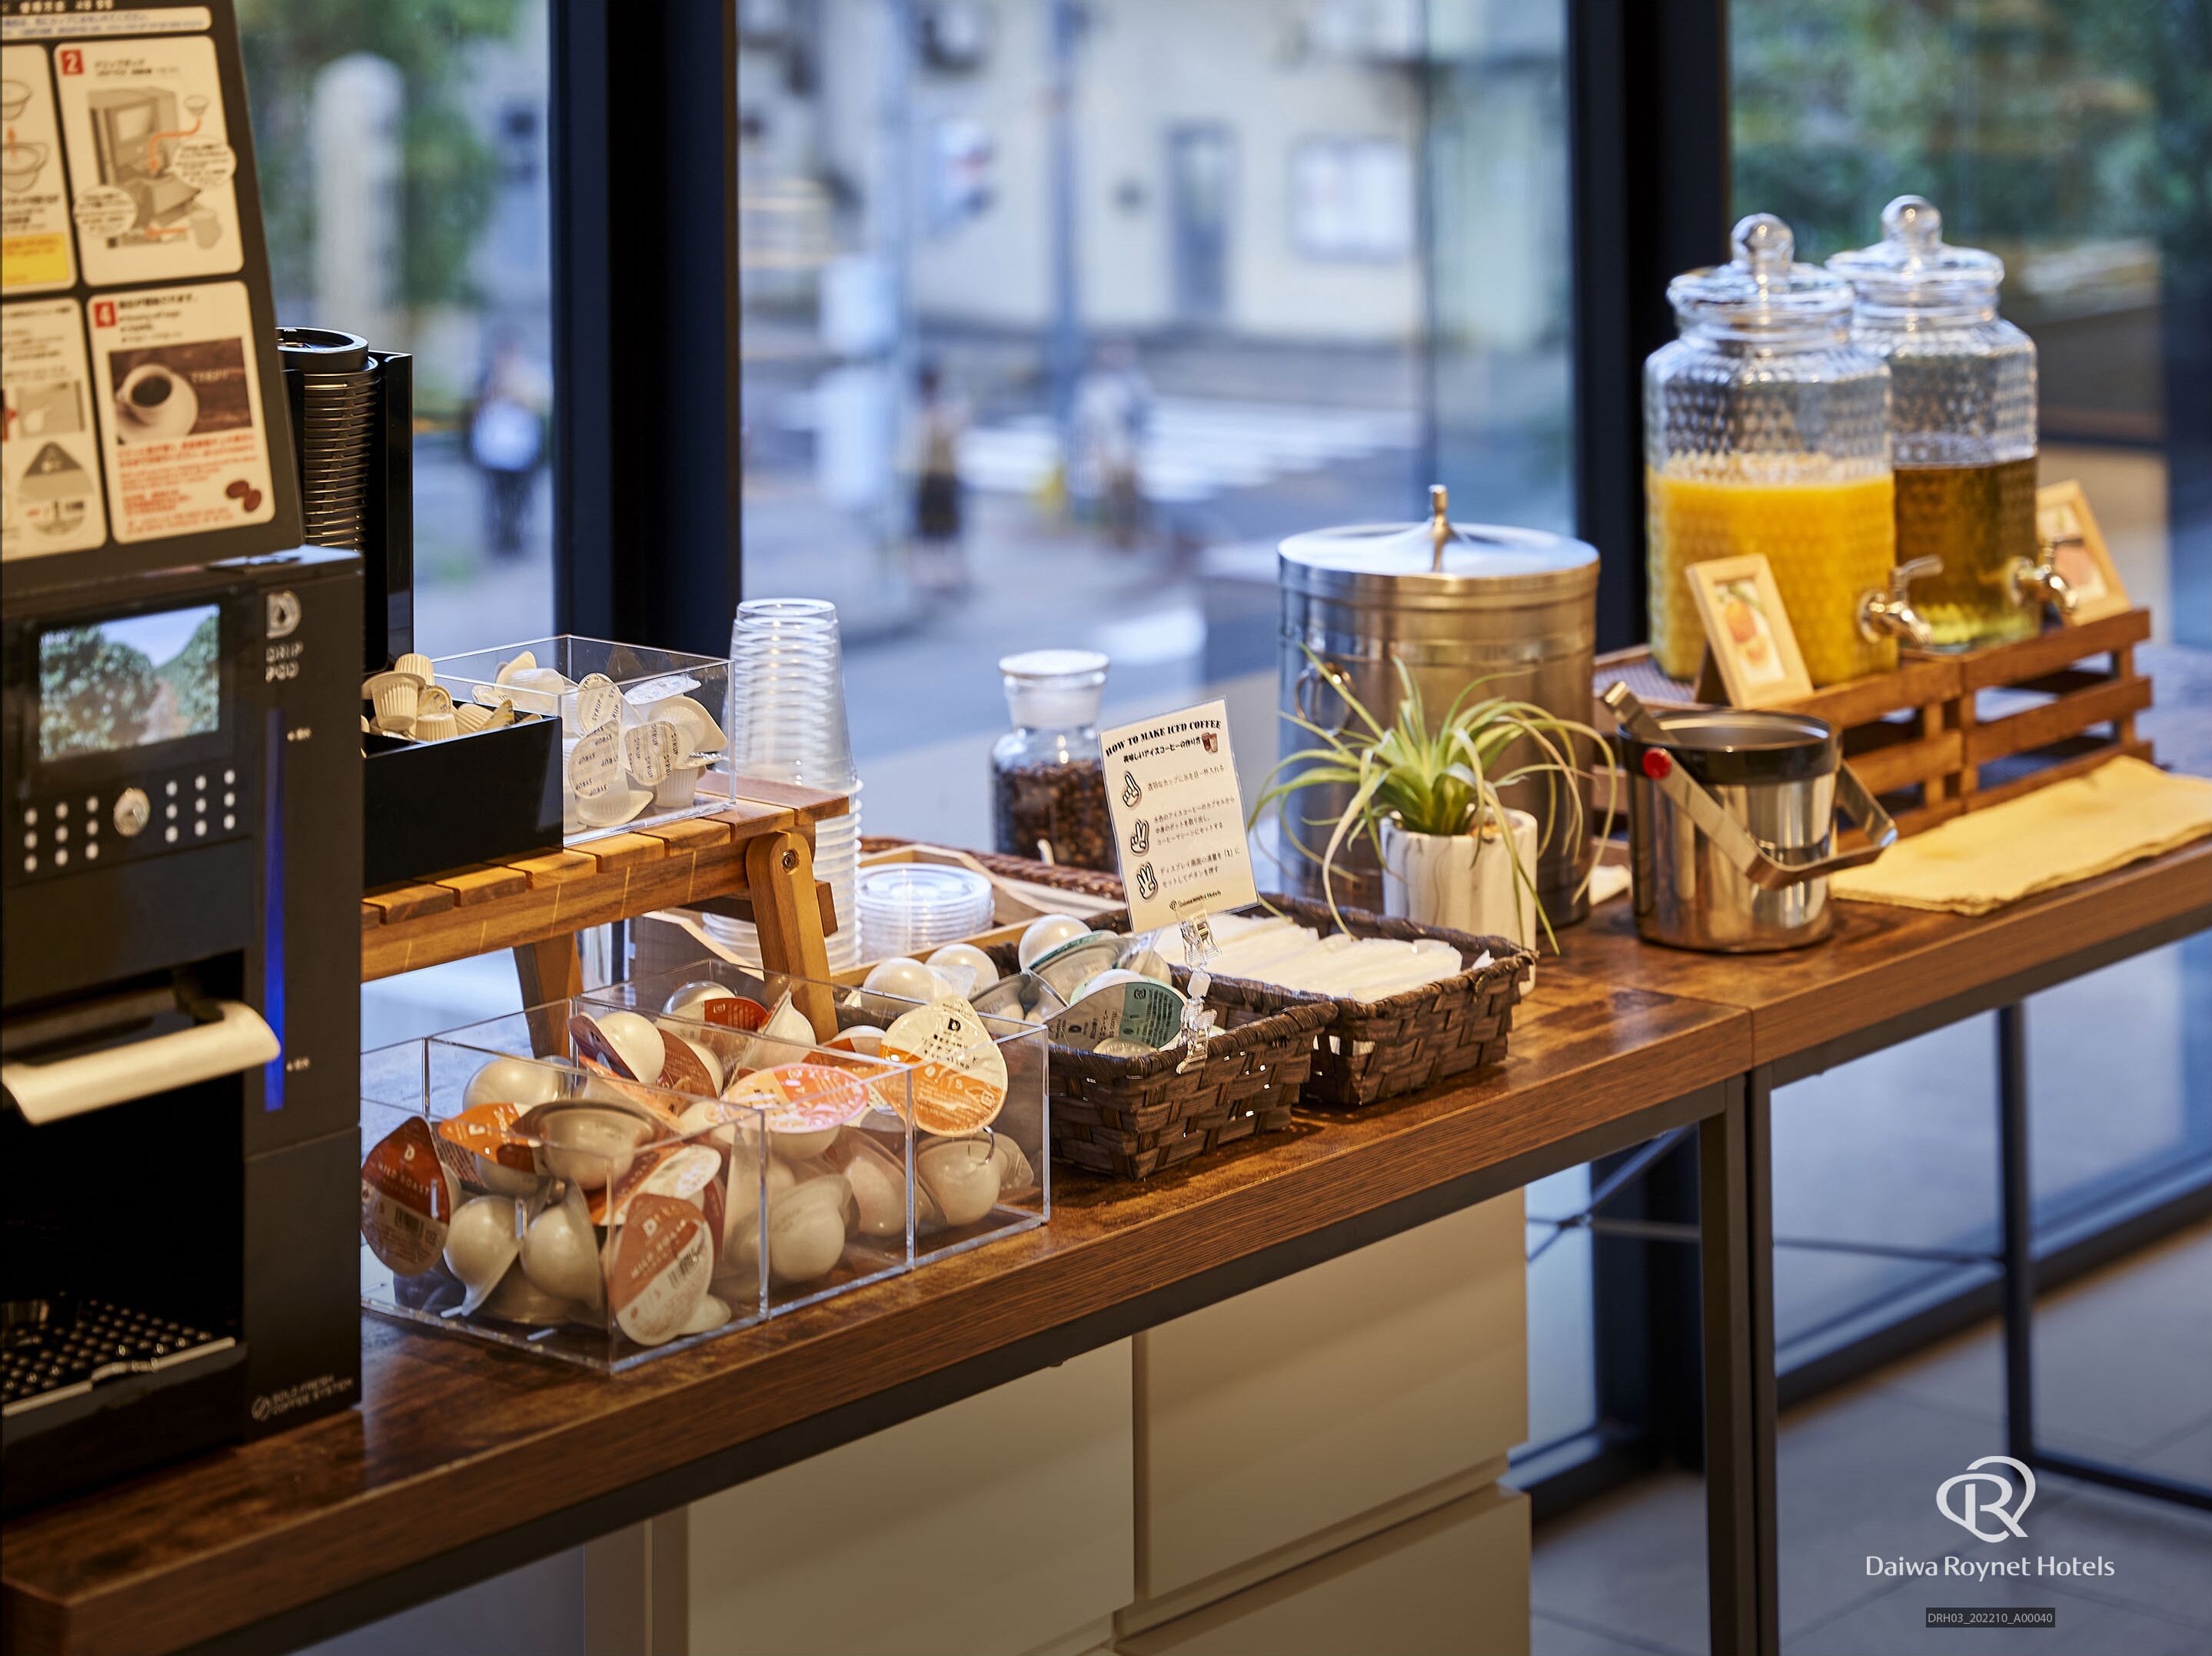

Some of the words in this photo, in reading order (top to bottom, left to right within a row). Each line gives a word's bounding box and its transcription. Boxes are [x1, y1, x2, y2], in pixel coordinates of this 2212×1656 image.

[65, 52, 79, 73] 2
[98, 304, 113, 324] 4
[1106, 739, 1126, 757] HOW
[1127, 735, 1139, 746] TO
[1141, 727, 1166, 742] MAKE
[1167, 723, 1187, 735] ICED
[1189, 720, 1222, 730] COFFEE
